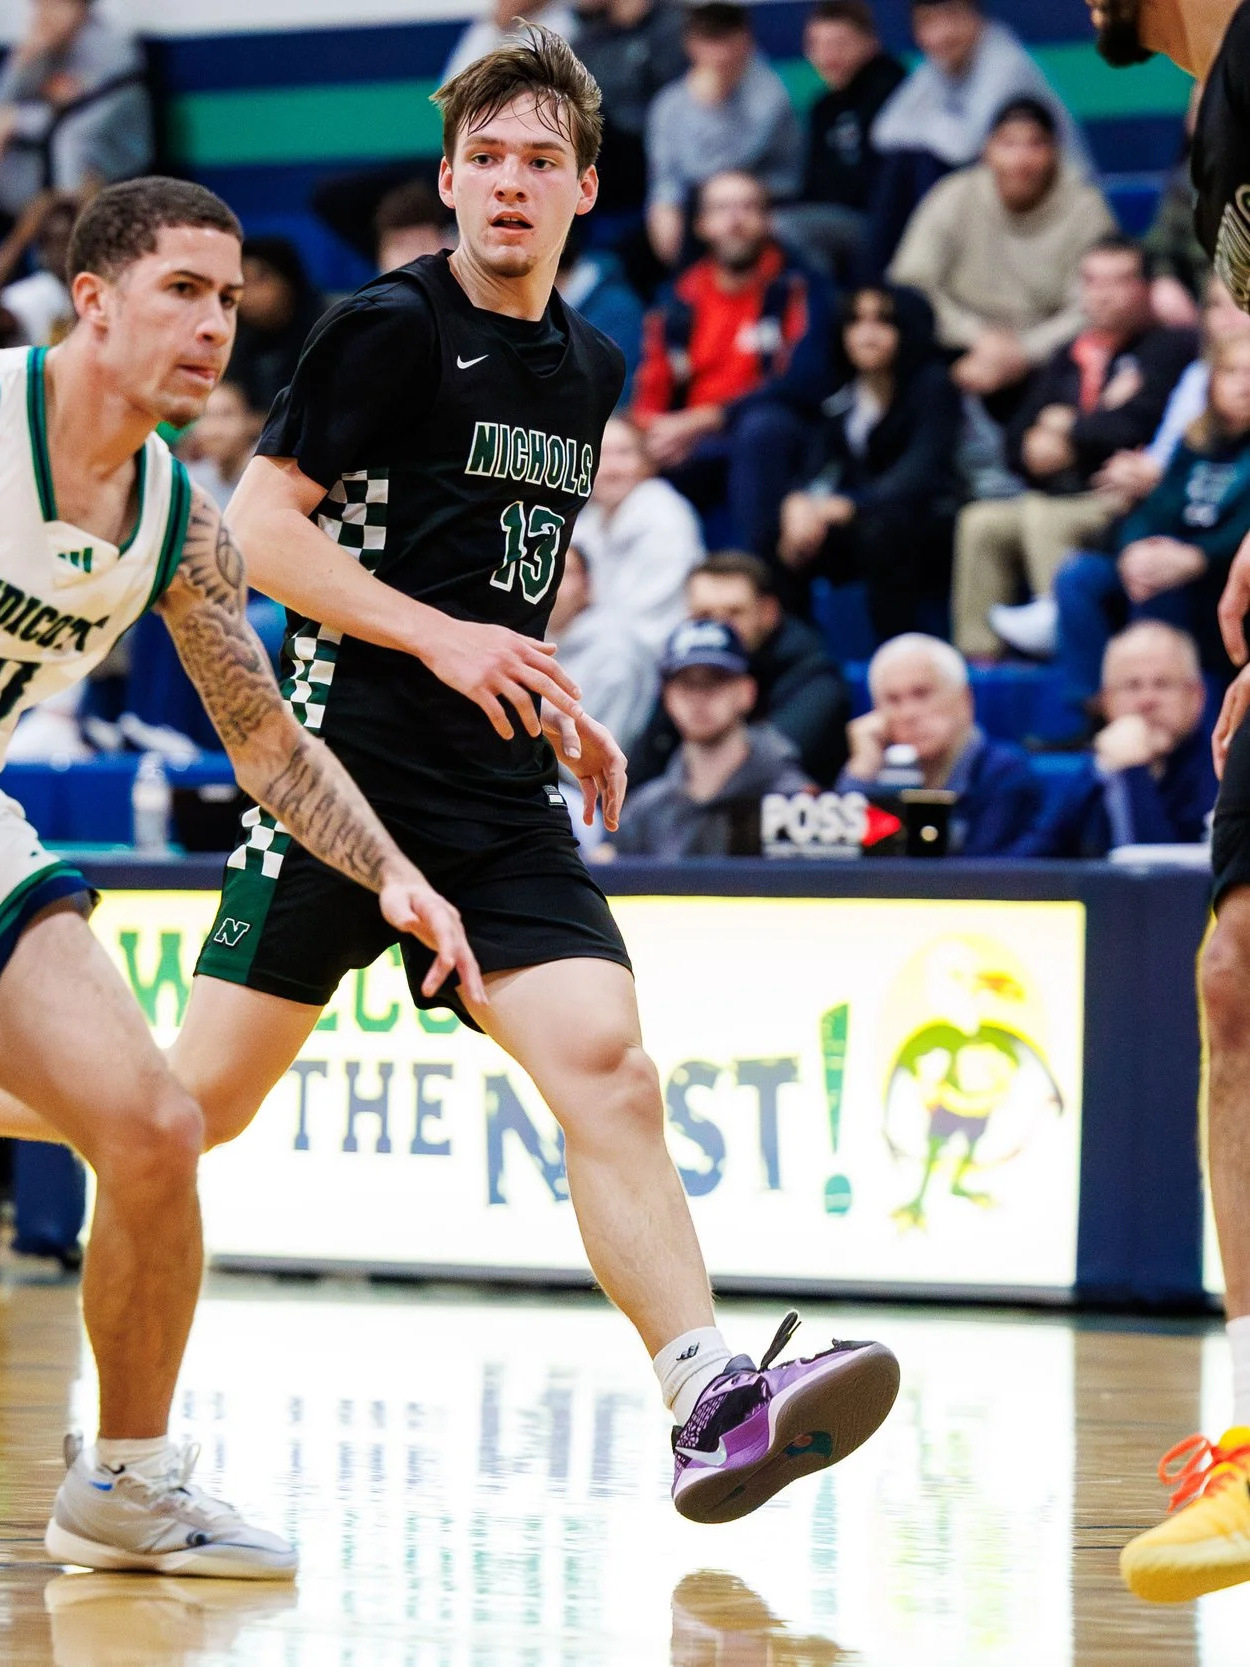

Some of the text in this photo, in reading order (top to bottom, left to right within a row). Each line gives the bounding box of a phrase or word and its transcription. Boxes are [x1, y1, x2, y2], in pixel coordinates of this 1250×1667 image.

[464, 421, 593, 498] NICHOLS
[489, 500, 566, 605] 13
[760, 791, 869, 849] POSS
[213, 917, 251, 947] N
[289, 1003, 852, 1216] THE NST!
